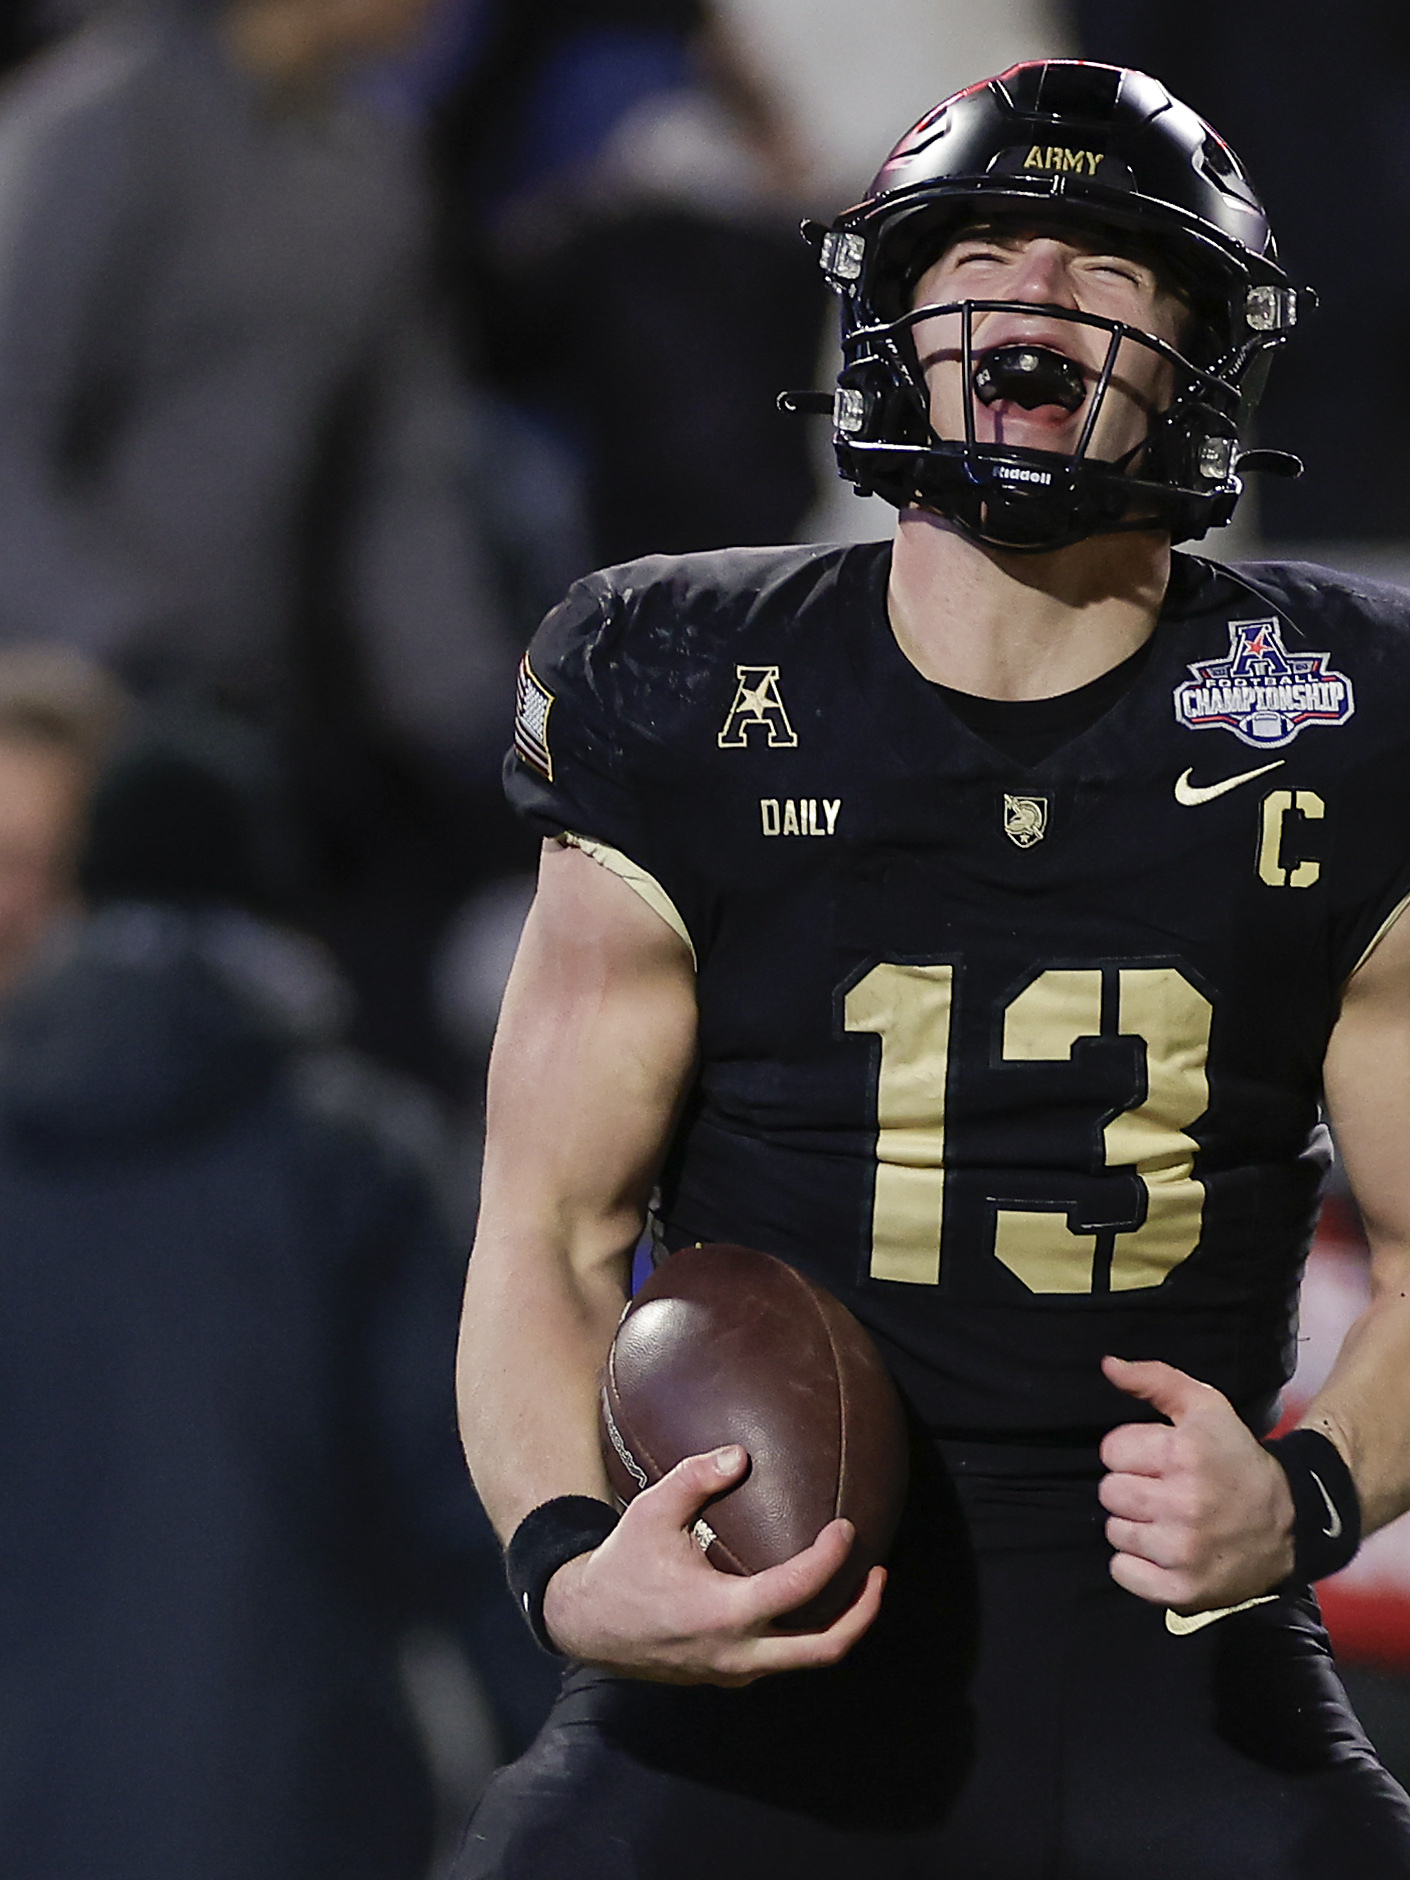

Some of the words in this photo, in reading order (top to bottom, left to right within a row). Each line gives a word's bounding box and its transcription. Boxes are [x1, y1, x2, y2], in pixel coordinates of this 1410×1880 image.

[1023, 145, 1104, 175] ARMY
[1206, 674, 1319, 688] FOOTBALL
[718, 665, 798, 747] A
[1182, 682, 1345, 718] CHAMPIONSHIP
[760, 799, 841, 836] DAILY
[1259, 790, 1325, 888] C
[844, 961, 1213, 1294] 13
